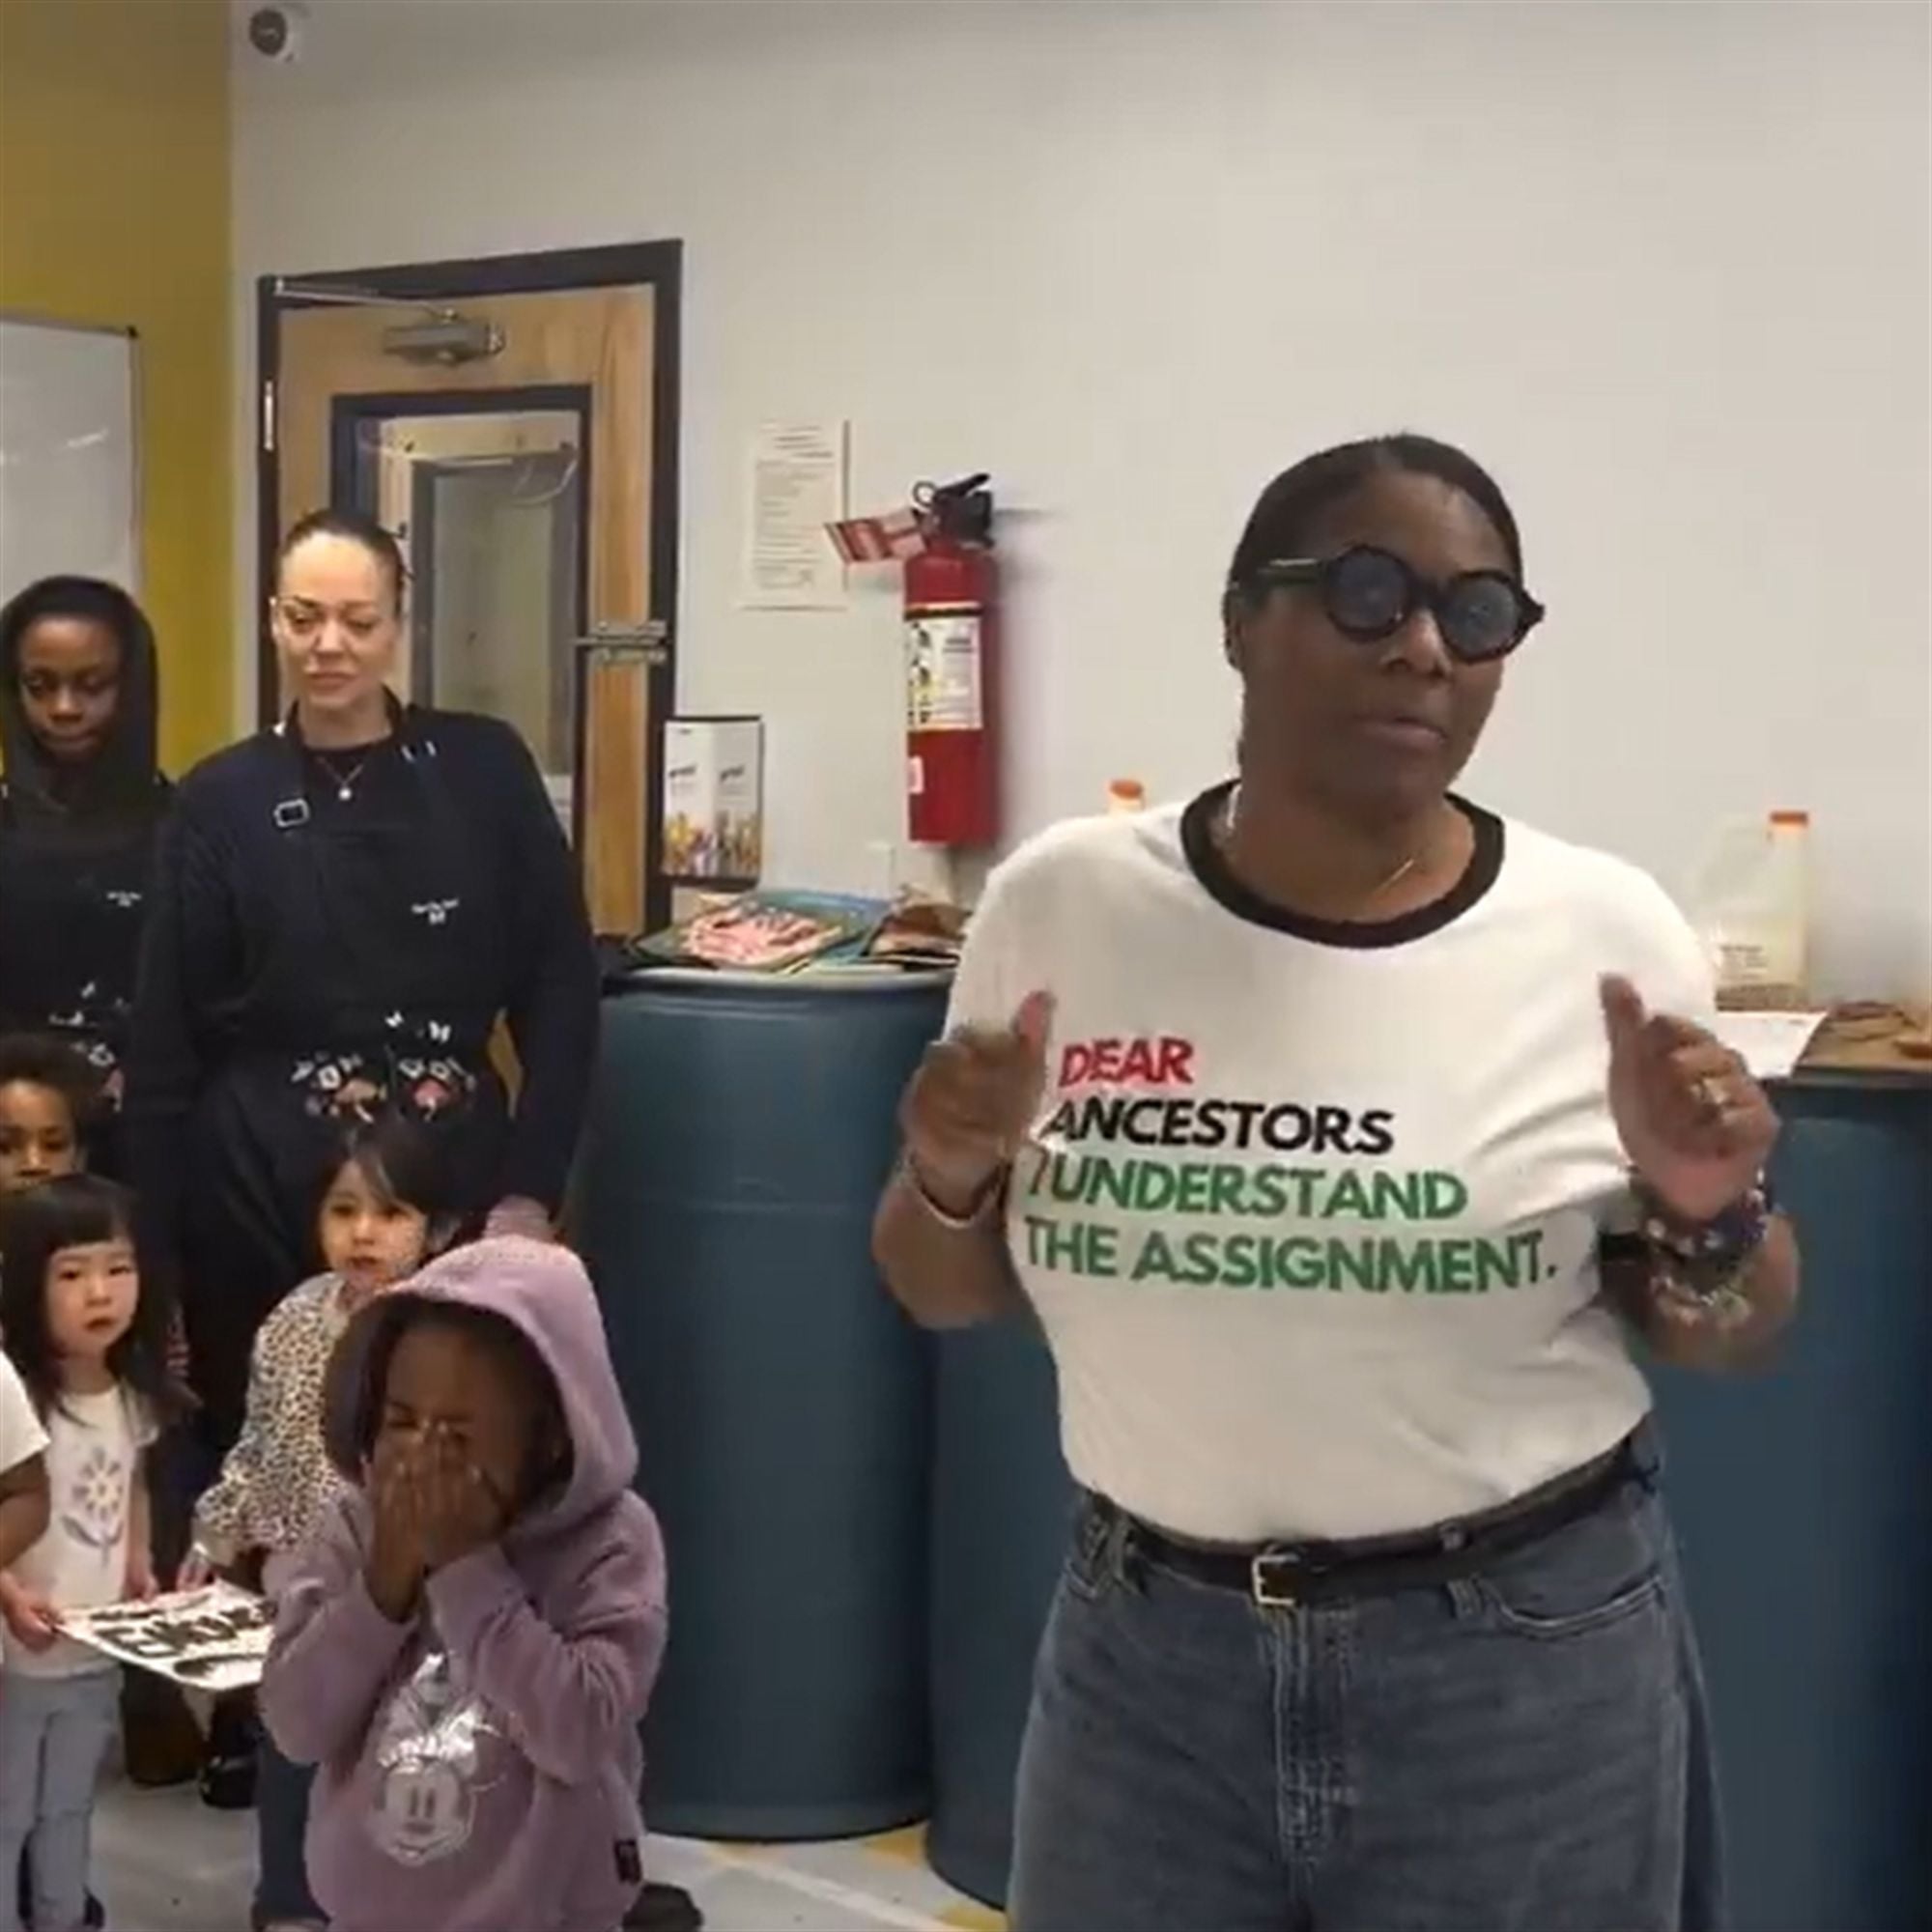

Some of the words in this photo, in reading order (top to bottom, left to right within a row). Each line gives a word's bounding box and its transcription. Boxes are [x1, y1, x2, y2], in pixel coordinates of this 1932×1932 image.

[1059, 1037, 1194, 1088] DEAR
[1038, 1095, 1394, 1154] ANCESTORS
[1051, 1153, 1467, 1220] UNDERSTAND
[1024, 1214, 1119, 1277] THE
[1130, 1230, 1556, 1293] ASSIGNMENT.
